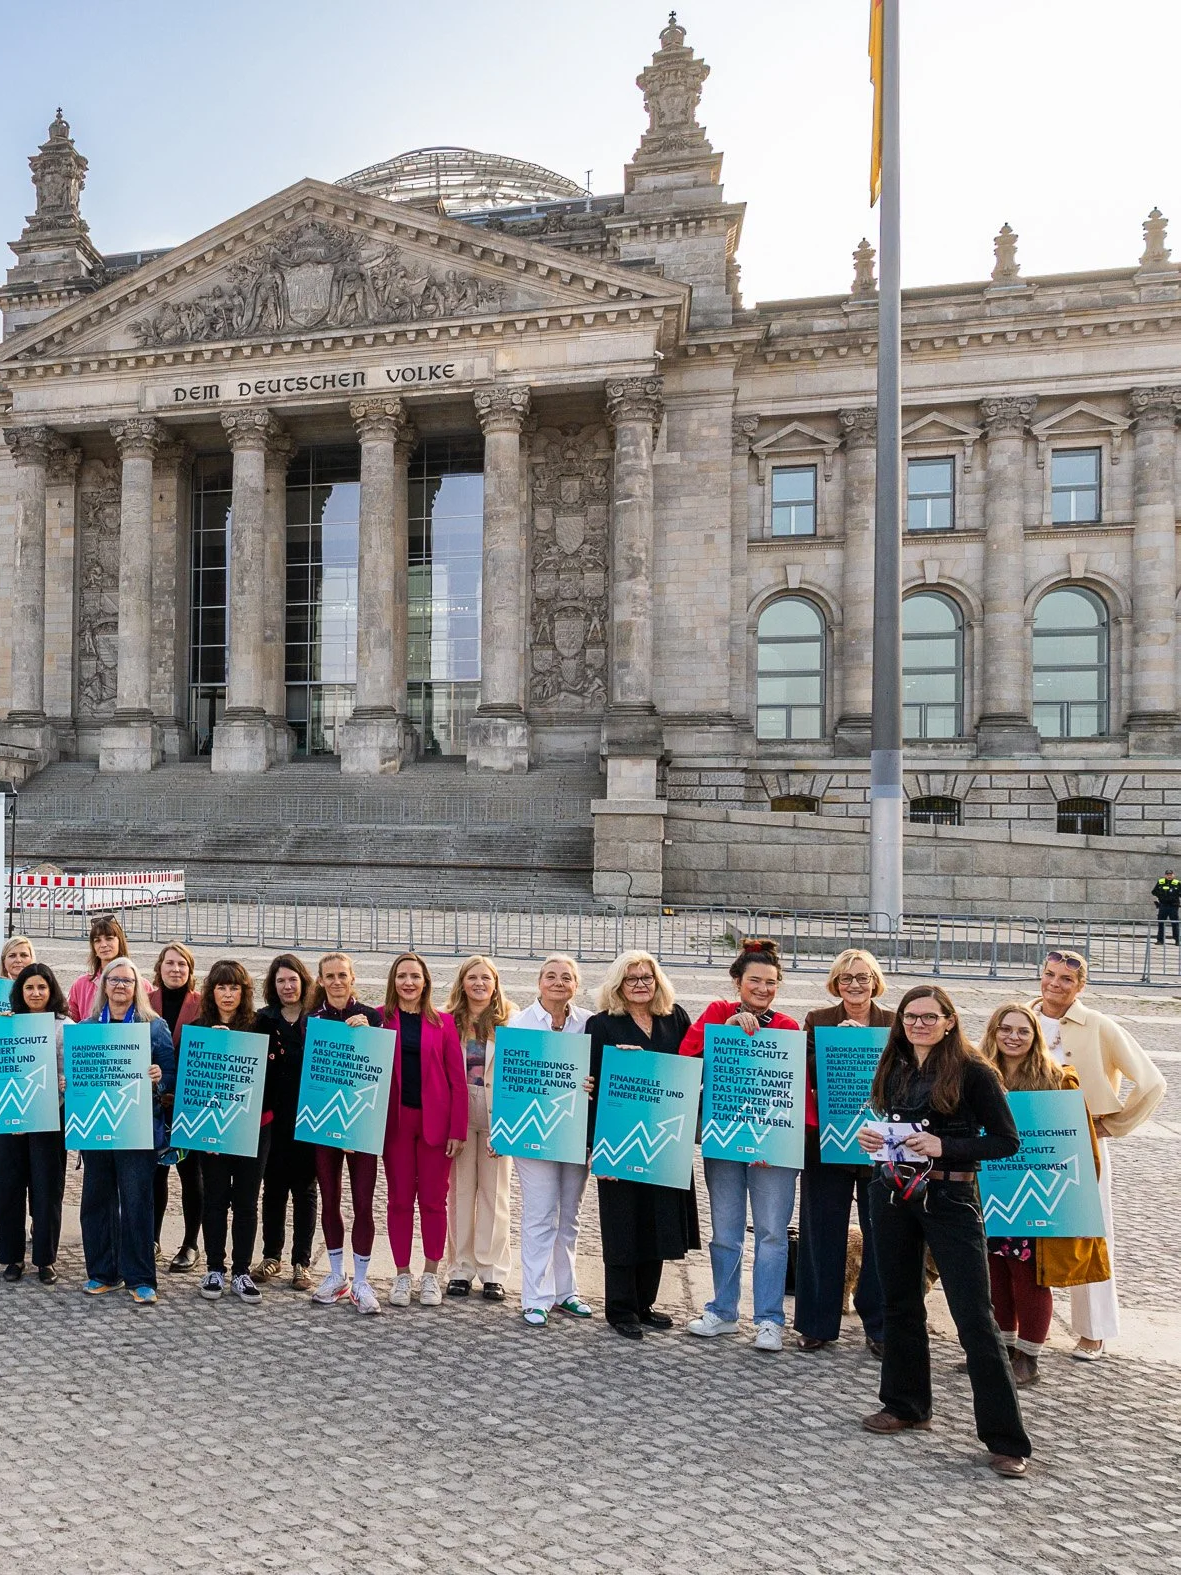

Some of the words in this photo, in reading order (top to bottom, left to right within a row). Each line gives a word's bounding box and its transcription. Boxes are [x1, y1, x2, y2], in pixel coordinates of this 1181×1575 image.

[174, 384, 219, 401] DEM
[238, 371, 365, 396] DEUTSCHEN
[386, 364, 455, 383] VOLKE
[189, 1041, 204, 1049] MIT
[329, 1042, 355, 1052] GUTER
[714, 1037, 749, 1048] DANKE,
[751, 1040, 777, 1049] DASS
[17, 1055, 35, 1063] UND
[187, 1051, 258, 1065] MUTTERSCHUTZ
[312, 1048, 369, 1063] ABSICHERUNG
[504, 1049, 529, 1058] ECHTE
[713, 1046, 788, 1060] MUTTERSCHUTZ
[187, 1059, 226, 1071] KÖNNEN
[228, 1065, 253, 1074] AUCH
[312, 1057, 331, 1065] SIND
[332, 1058, 363, 1070] FAMILIE
[365, 1066, 382, 1074] UND
[503, 1058, 578, 1071] ENTSCHEIDUNGS-
[713, 1056, 739, 1065] AUCH
[186, 1070, 254, 1084] SCHAUSPIELER-
[311, 1065, 378, 1082] BESTLEISTUNGEN
[503, 1067, 538, 1076] FREIHEIT
[713, 1065, 793, 1080] SELBSTSTÄNDIGE
[185, 1079, 213, 1089] INNEN
[215, 1082, 235, 1091] IHRE
[310, 1073, 356, 1087] VEREINBAR.
[502, 1076, 576, 1089] KINDERPLANUNG
[610, 1074, 660, 1087] FINANZIELLE
[713, 1074, 758, 1086] SCHÜTZT.
[761, 1079, 792, 1089] DAMIT
[184, 1088, 211, 1098] ROLLE
[214, 1092, 245, 1102] SELBST
[509, 1082, 524, 1092] FÜR
[527, 1085, 550, 1095] ALLE.
[609, 1082, 664, 1096] PLANBARKEIT
[713, 1084, 731, 1092] DAS
[734, 1086, 793, 1100] HANDWERK,
[183, 1096, 224, 1109] WÄHLEN.
[608, 1091, 637, 1100] INNERE
[639, 1095, 661, 1103] RUHE
[713, 1094, 770, 1106] EXISTENZEN
[773, 1099, 793, 1108] UND
[712, 1103, 743, 1113] TEAMS
[746, 1106, 767, 1115] EINE
[712, 1112, 756, 1124] ZUKUNFT
[758, 1117, 794, 1128] HABEN.
[987, 1163, 1067, 1171] ERWERBSFORMEN
